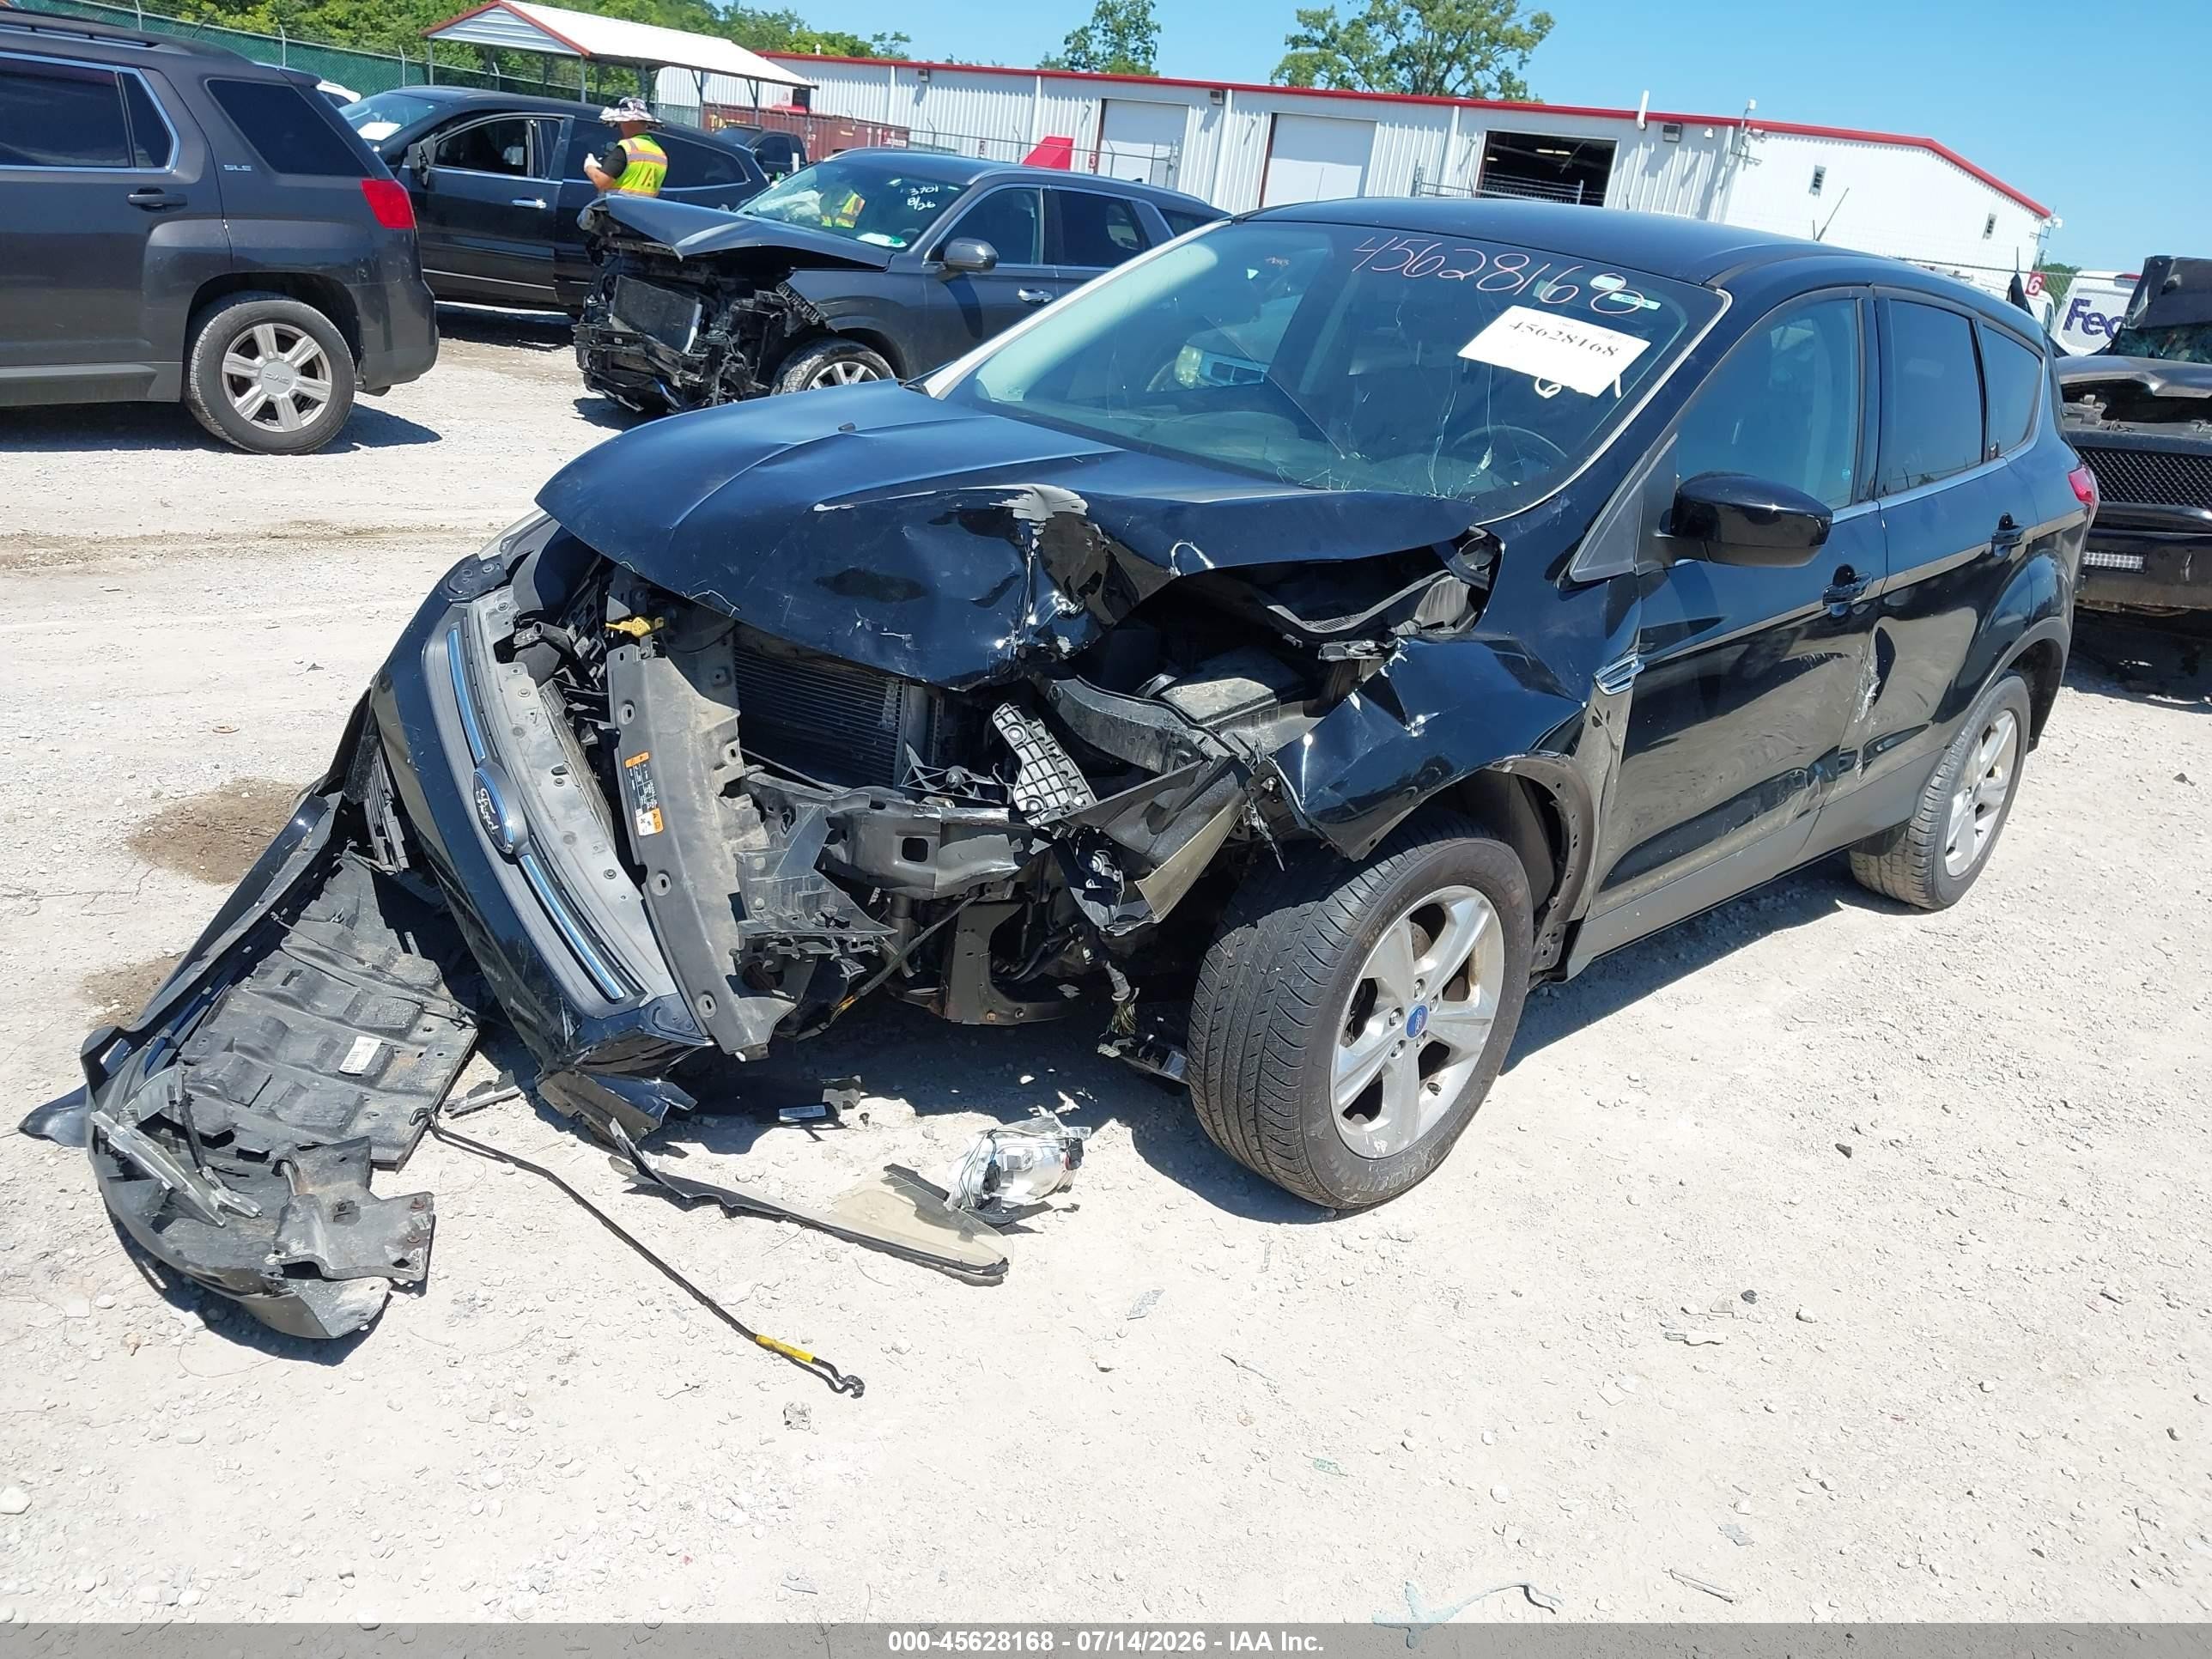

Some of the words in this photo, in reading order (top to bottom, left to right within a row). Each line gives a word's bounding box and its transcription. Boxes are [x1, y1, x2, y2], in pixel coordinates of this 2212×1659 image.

[1352, 236, 1645, 314] 45628168
[2027, 276, 2043, 294] 6
[1509, 321, 1620, 357] 45628168
[475, 787, 500, 835] Ford
